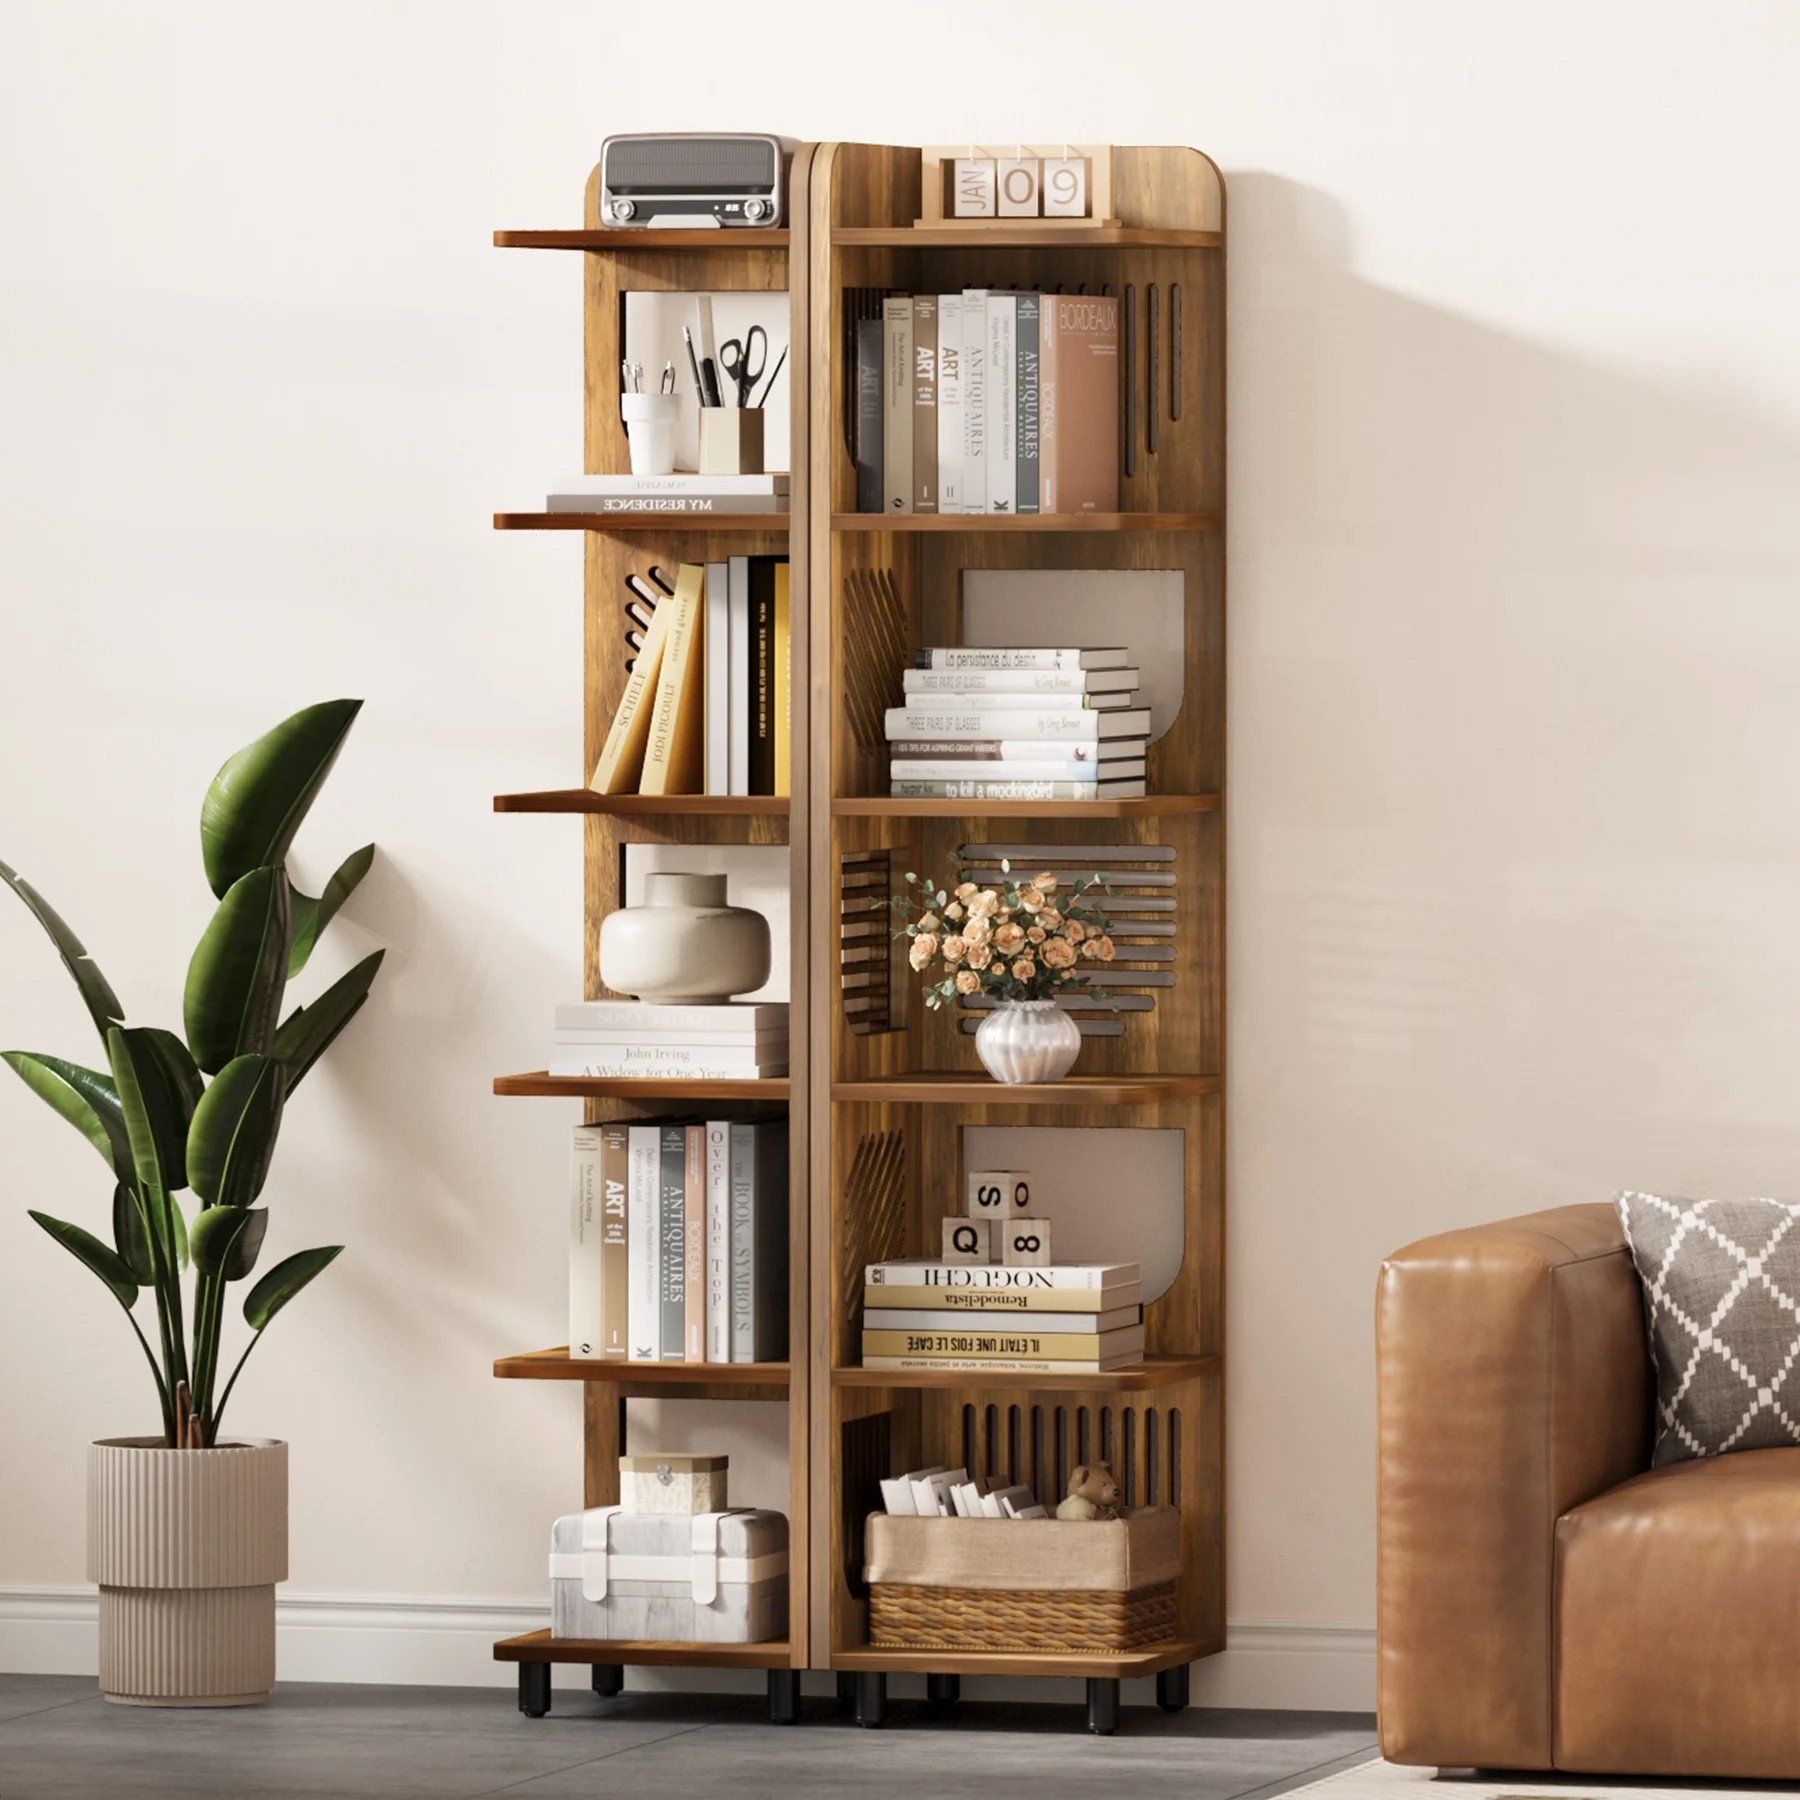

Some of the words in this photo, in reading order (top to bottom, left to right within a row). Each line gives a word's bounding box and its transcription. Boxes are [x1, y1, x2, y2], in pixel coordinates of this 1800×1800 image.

[961, 171, 986, 210] JAN
[1060, 303, 1117, 330] BORDEAUX
[917, 347, 935, 382] ART
[942, 347, 958, 381] ART
[861, 365, 879, 396] ART
[970, 347, 983, 457] ANTIQUAIRES
[1023, 351, 1038, 459] ANTIQUAIRES
[1042, 382, 1054, 440] BORDEAUX
[676, 597, 689, 628] glance
[671, 630, 683, 662] second
[618, 670, 648, 727] SCHIELE
[657, 683, 676, 732] PICOULT
[927, 717, 944, 731] PAIRS
[946, 717, 953, 731] OF
[955, 717, 981, 731] GLASSES
[652, 736, 666, 763] JODI
[919, 744, 930, 752] FOR
[945, 783, 958, 798] to
[960, 781, 974, 798] kill
[976, 784, 984, 798] a
[623, 1047, 651, 1061] John
[655, 1048, 691, 1062] Irving
[581, 1065, 592, 1077] A
[596, 1065, 641, 1078] Widow
[645, 1065, 663, 1078] for
[667, 1066, 696, 1079] One
[699, 1067, 727, 1080] Year
[605, 1180, 625, 1218] ART
[735, 1182, 751, 1229] BOOK
[667, 1186, 684, 1303] ANTIQUAIRES
[689, 1221, 701, 1283] BORDEAUX
[952, 1226, 979, 1255] Q
[1013, 1235, 1040, 1253] 8
[735, 1247, 751, 1332] SYMBOLS
[924, 1268, 1054, 1289] NOGUCHI
[945, 1294, 1028, 1308] Remodelista
[907, 1336, 933, 1353] CAFÉ
[936, 1336, 948, 1351] LE
[950, 1336, 973, 1351] FOIS
[976, 1337, 997, 1352] UNE
[1000, 1338, 1028, 1354] ÉTAIT
[1030, 1339, 1040, 1352] IL
